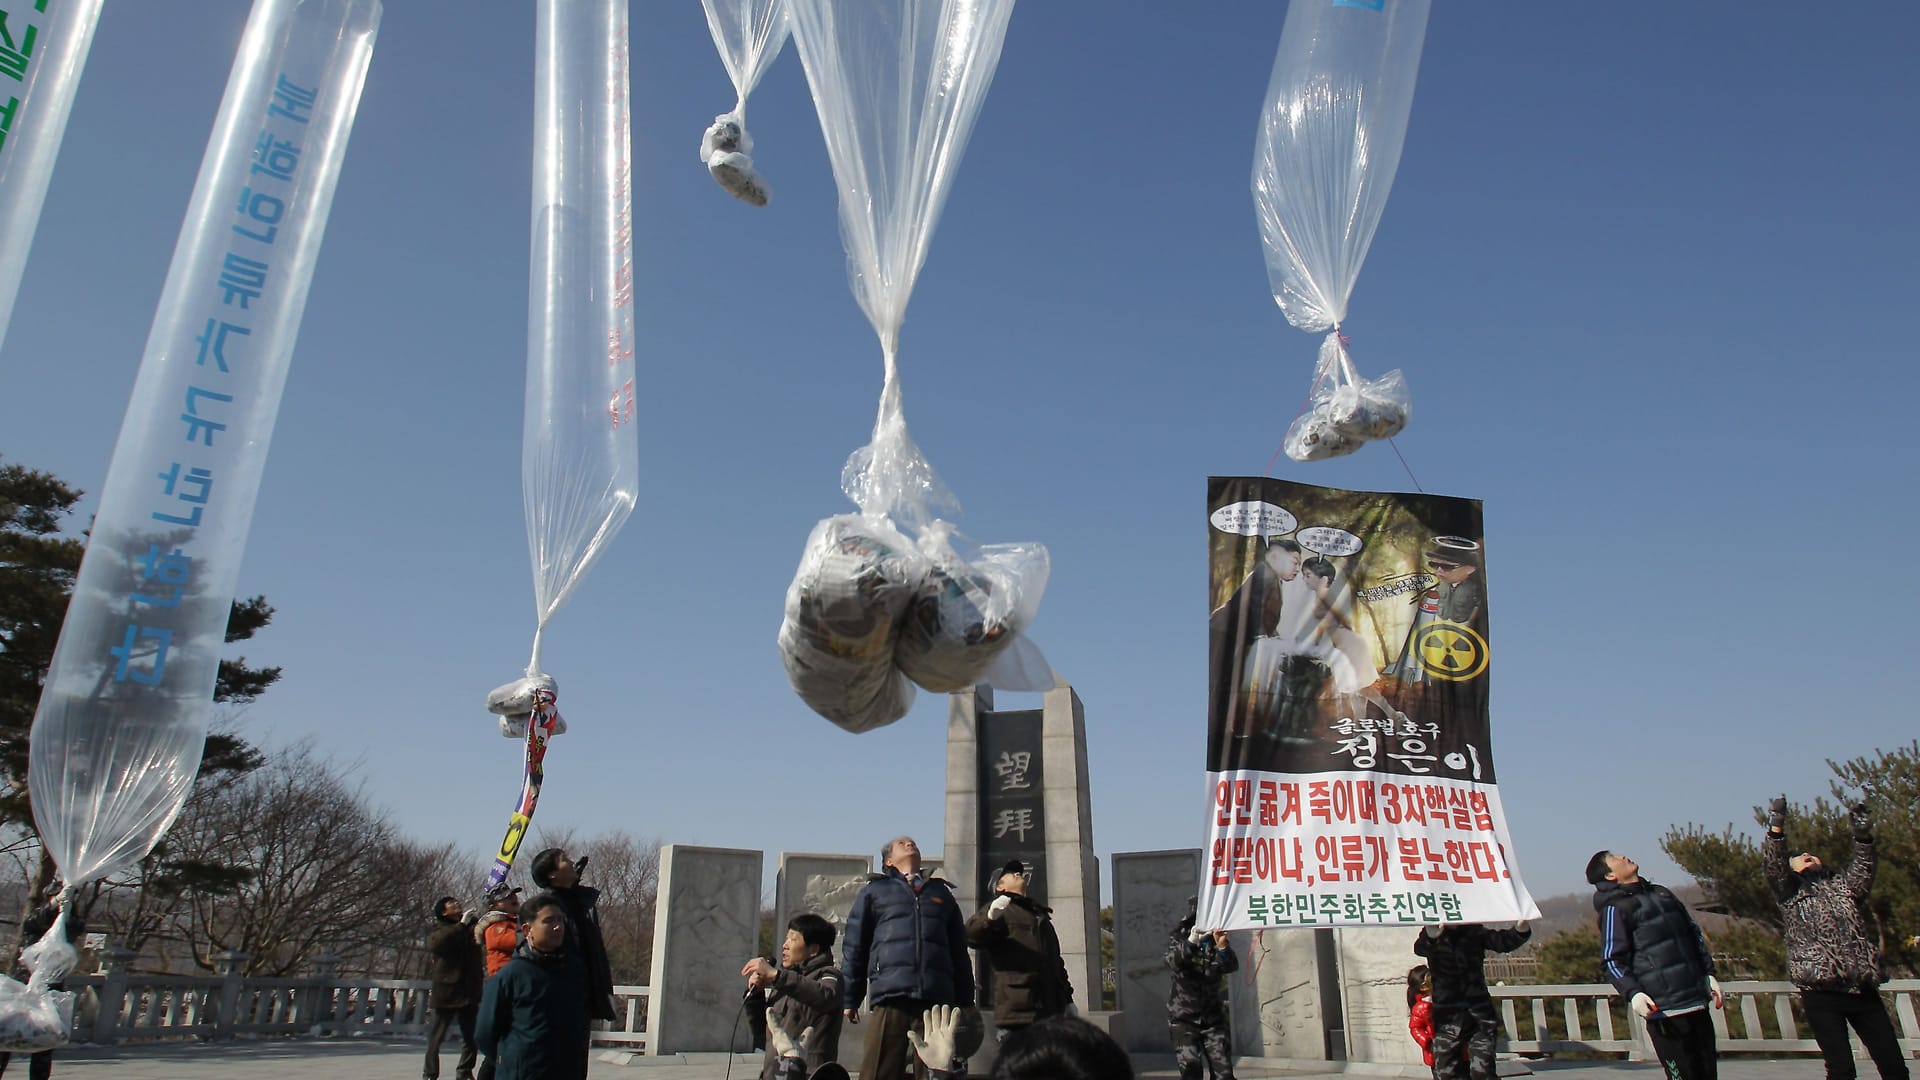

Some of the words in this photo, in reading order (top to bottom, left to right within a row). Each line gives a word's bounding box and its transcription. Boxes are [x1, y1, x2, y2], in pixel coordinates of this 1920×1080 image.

[1329, 717, 1395, 736] 글로벌
[1396, 720, 1441, 741] 호구
[1215, 779, 1252, 827] 인민
[1259, 780, 1302, 827] 굶겨
[1247, 892, 1463, 925] 북한민주화추진연합
